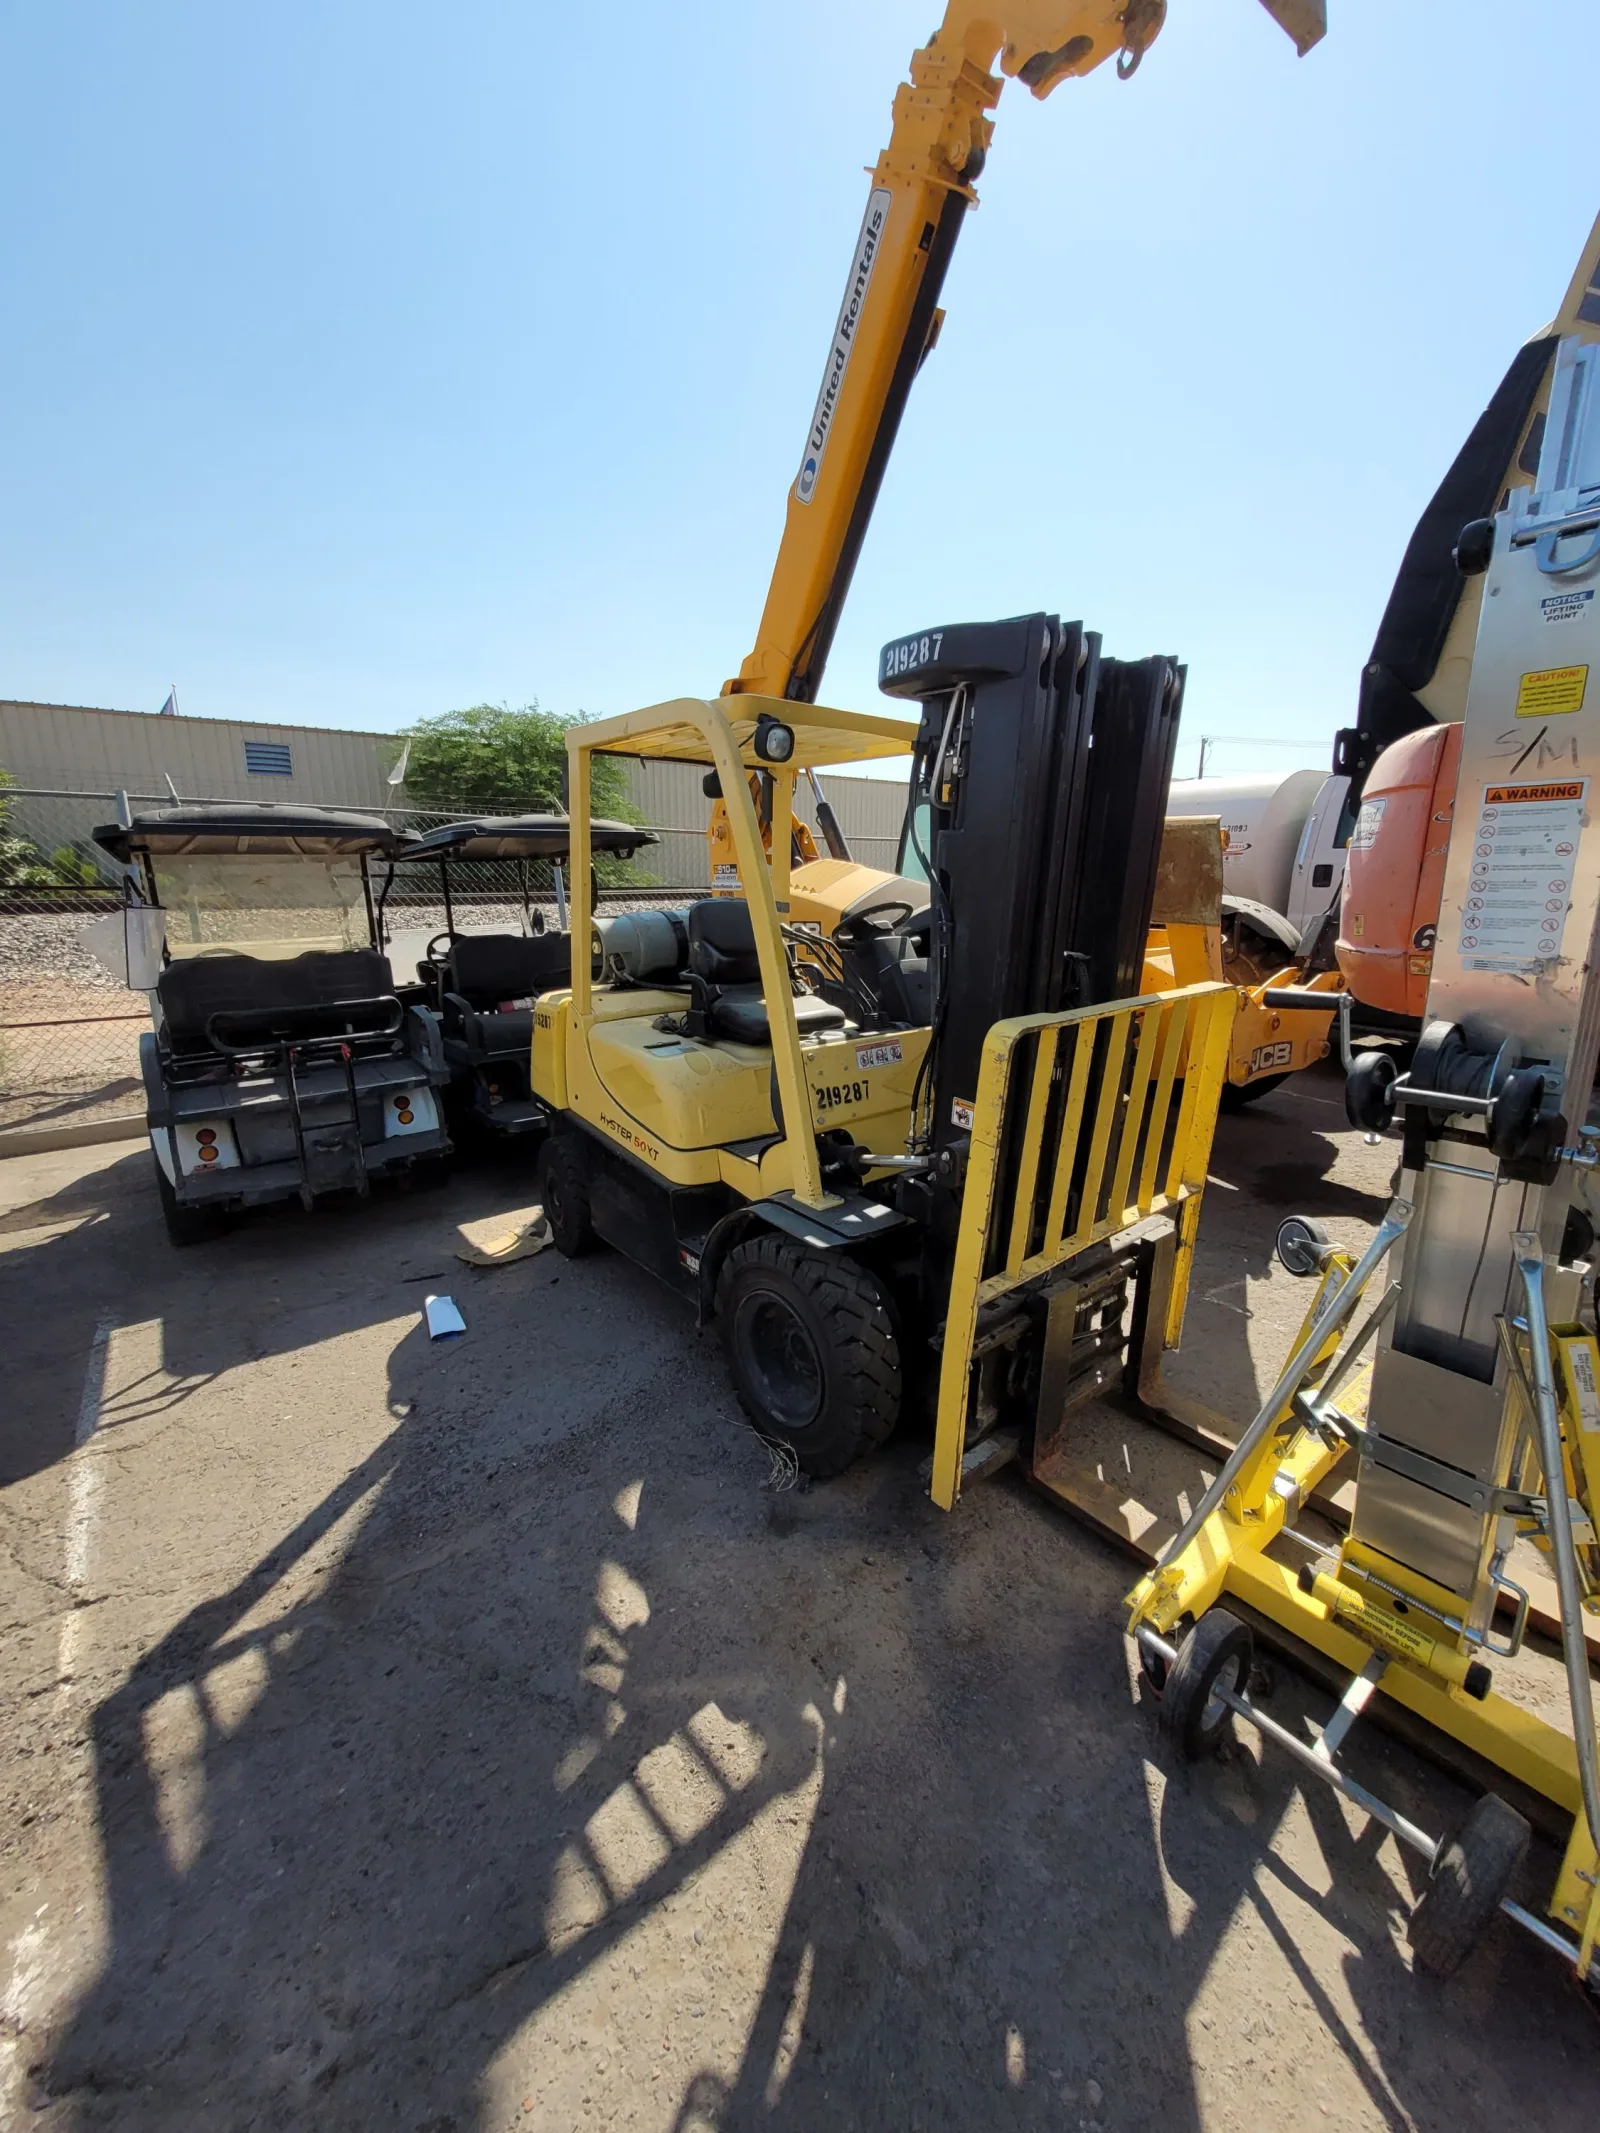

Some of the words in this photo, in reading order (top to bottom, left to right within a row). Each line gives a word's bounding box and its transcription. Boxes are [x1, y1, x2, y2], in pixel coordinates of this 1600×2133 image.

[812, 347, 846, 452] United
[840, 209, 883, 341] Rentals
[1545, 592, 1587, 607] NOTICE
[1543, 603, 1584, 616] LIFTING
[1546, 611, 1578, 622] POINT
[886, 632, 944, 677] 219287
[1527, 670, 1581, 684] CAUTION!
[1507, 785, 1579, 801] WARNING
[1251, 1043, 1291, 1072] JCB
[815, 1080, 870, 1110] 219287
[600, 1111, 633, 1142] HYSTER
[1394, 1628, 1421, 1647] BEFORE
